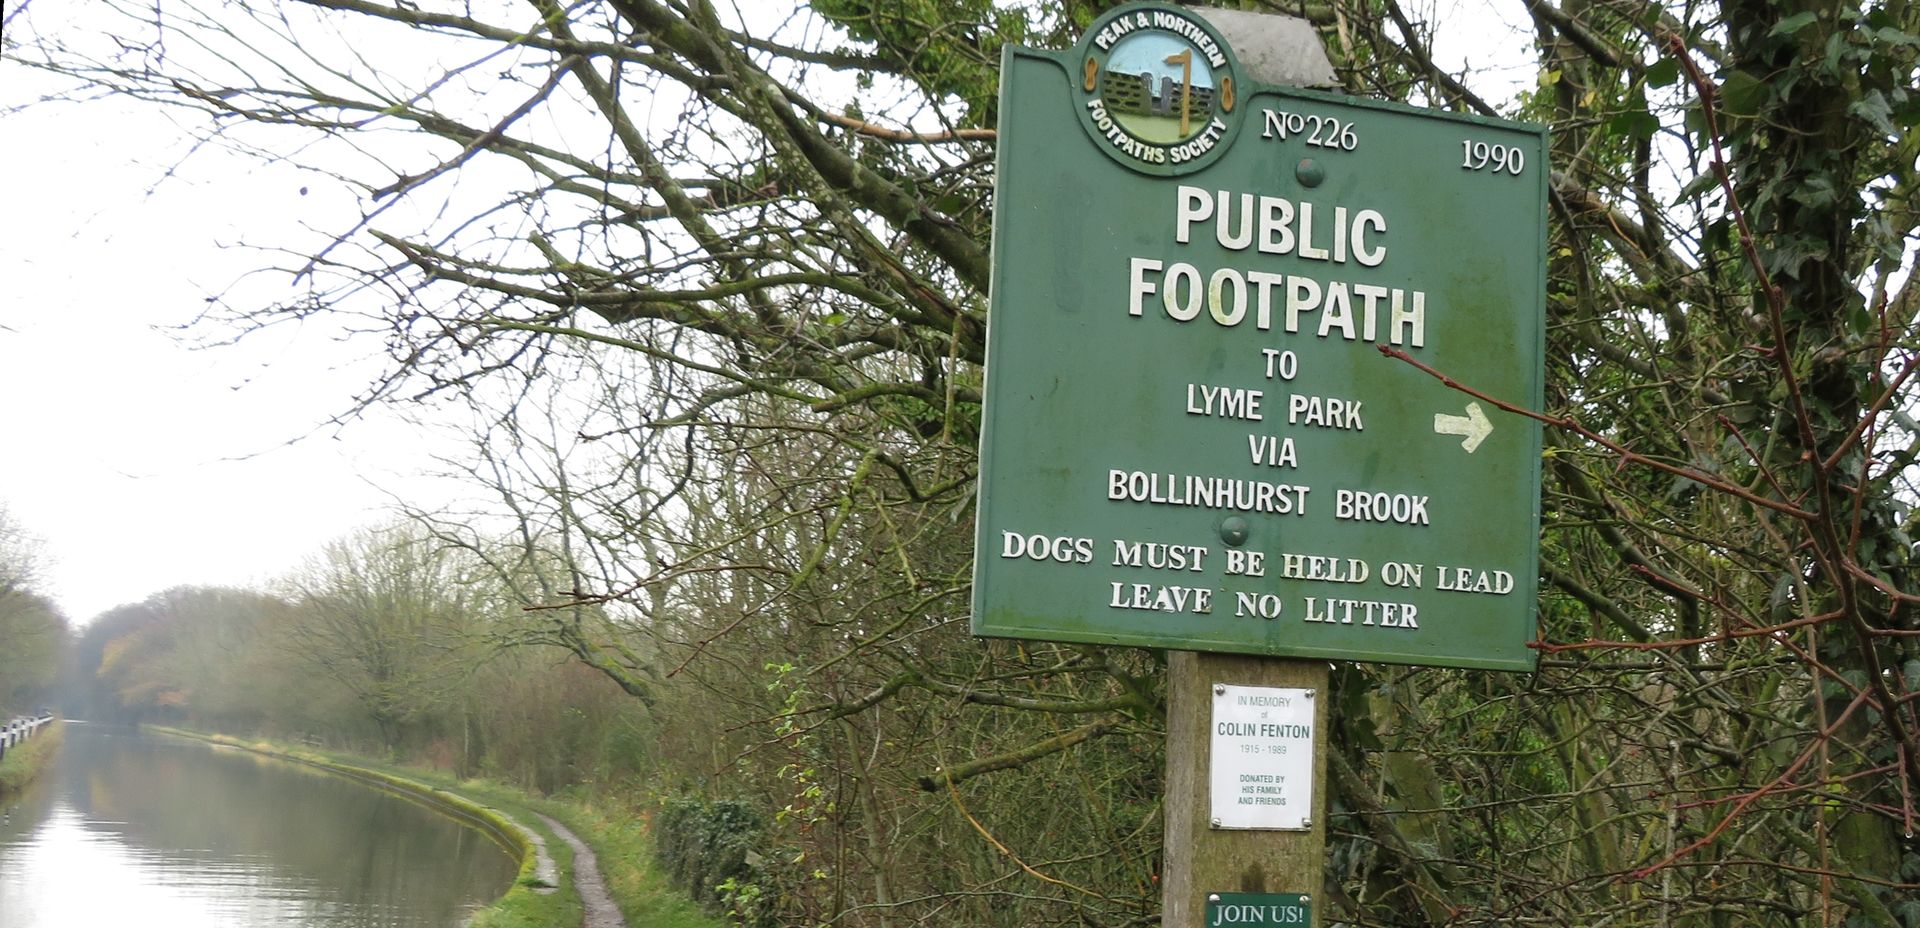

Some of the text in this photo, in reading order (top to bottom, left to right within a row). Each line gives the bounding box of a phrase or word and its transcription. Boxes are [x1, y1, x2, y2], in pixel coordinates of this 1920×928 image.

[1094, 11, 1227, 69] PEAK & NORTHERN
[1087, 98, 1228, 164] FOOTPATHS SOCIETY
[1462, 139, 1525, 176] 1990
[1176, 184, 1387, 267] PUBLIC
[1128, 256, 1426, 348] FOOTPATH
[1262, 348, 1297, 380] TO
[1186, 383, 1364, 431] LYME PARK
[1248, 434, 1298, 468] VIA
[1107, 469, 1430, 525] BOLLINHURST BROOK
[1001, 529, 1515, 596] DOGS MUST BE HELD ON LEAD
[1109, 581, 1419, 629] LEAVE NO LITTER
[1237, 695, 1292, 708] IN MEMORY
[1261, 710, 1269, 719] of
[1217, 721, 1310, 739] COLIN FENTON
[1240, 743, 1260, 754] 1915
[1267, 744, 1287, 755] 1989
[1239, 774, 1286, 784] DONATED BY
[1241, 785, 1283, 795] HIS FAMILY
[1237, 796, 1287, 806] AND FRIENDS
[1212, 905, 1303, 927] JOIN US!
